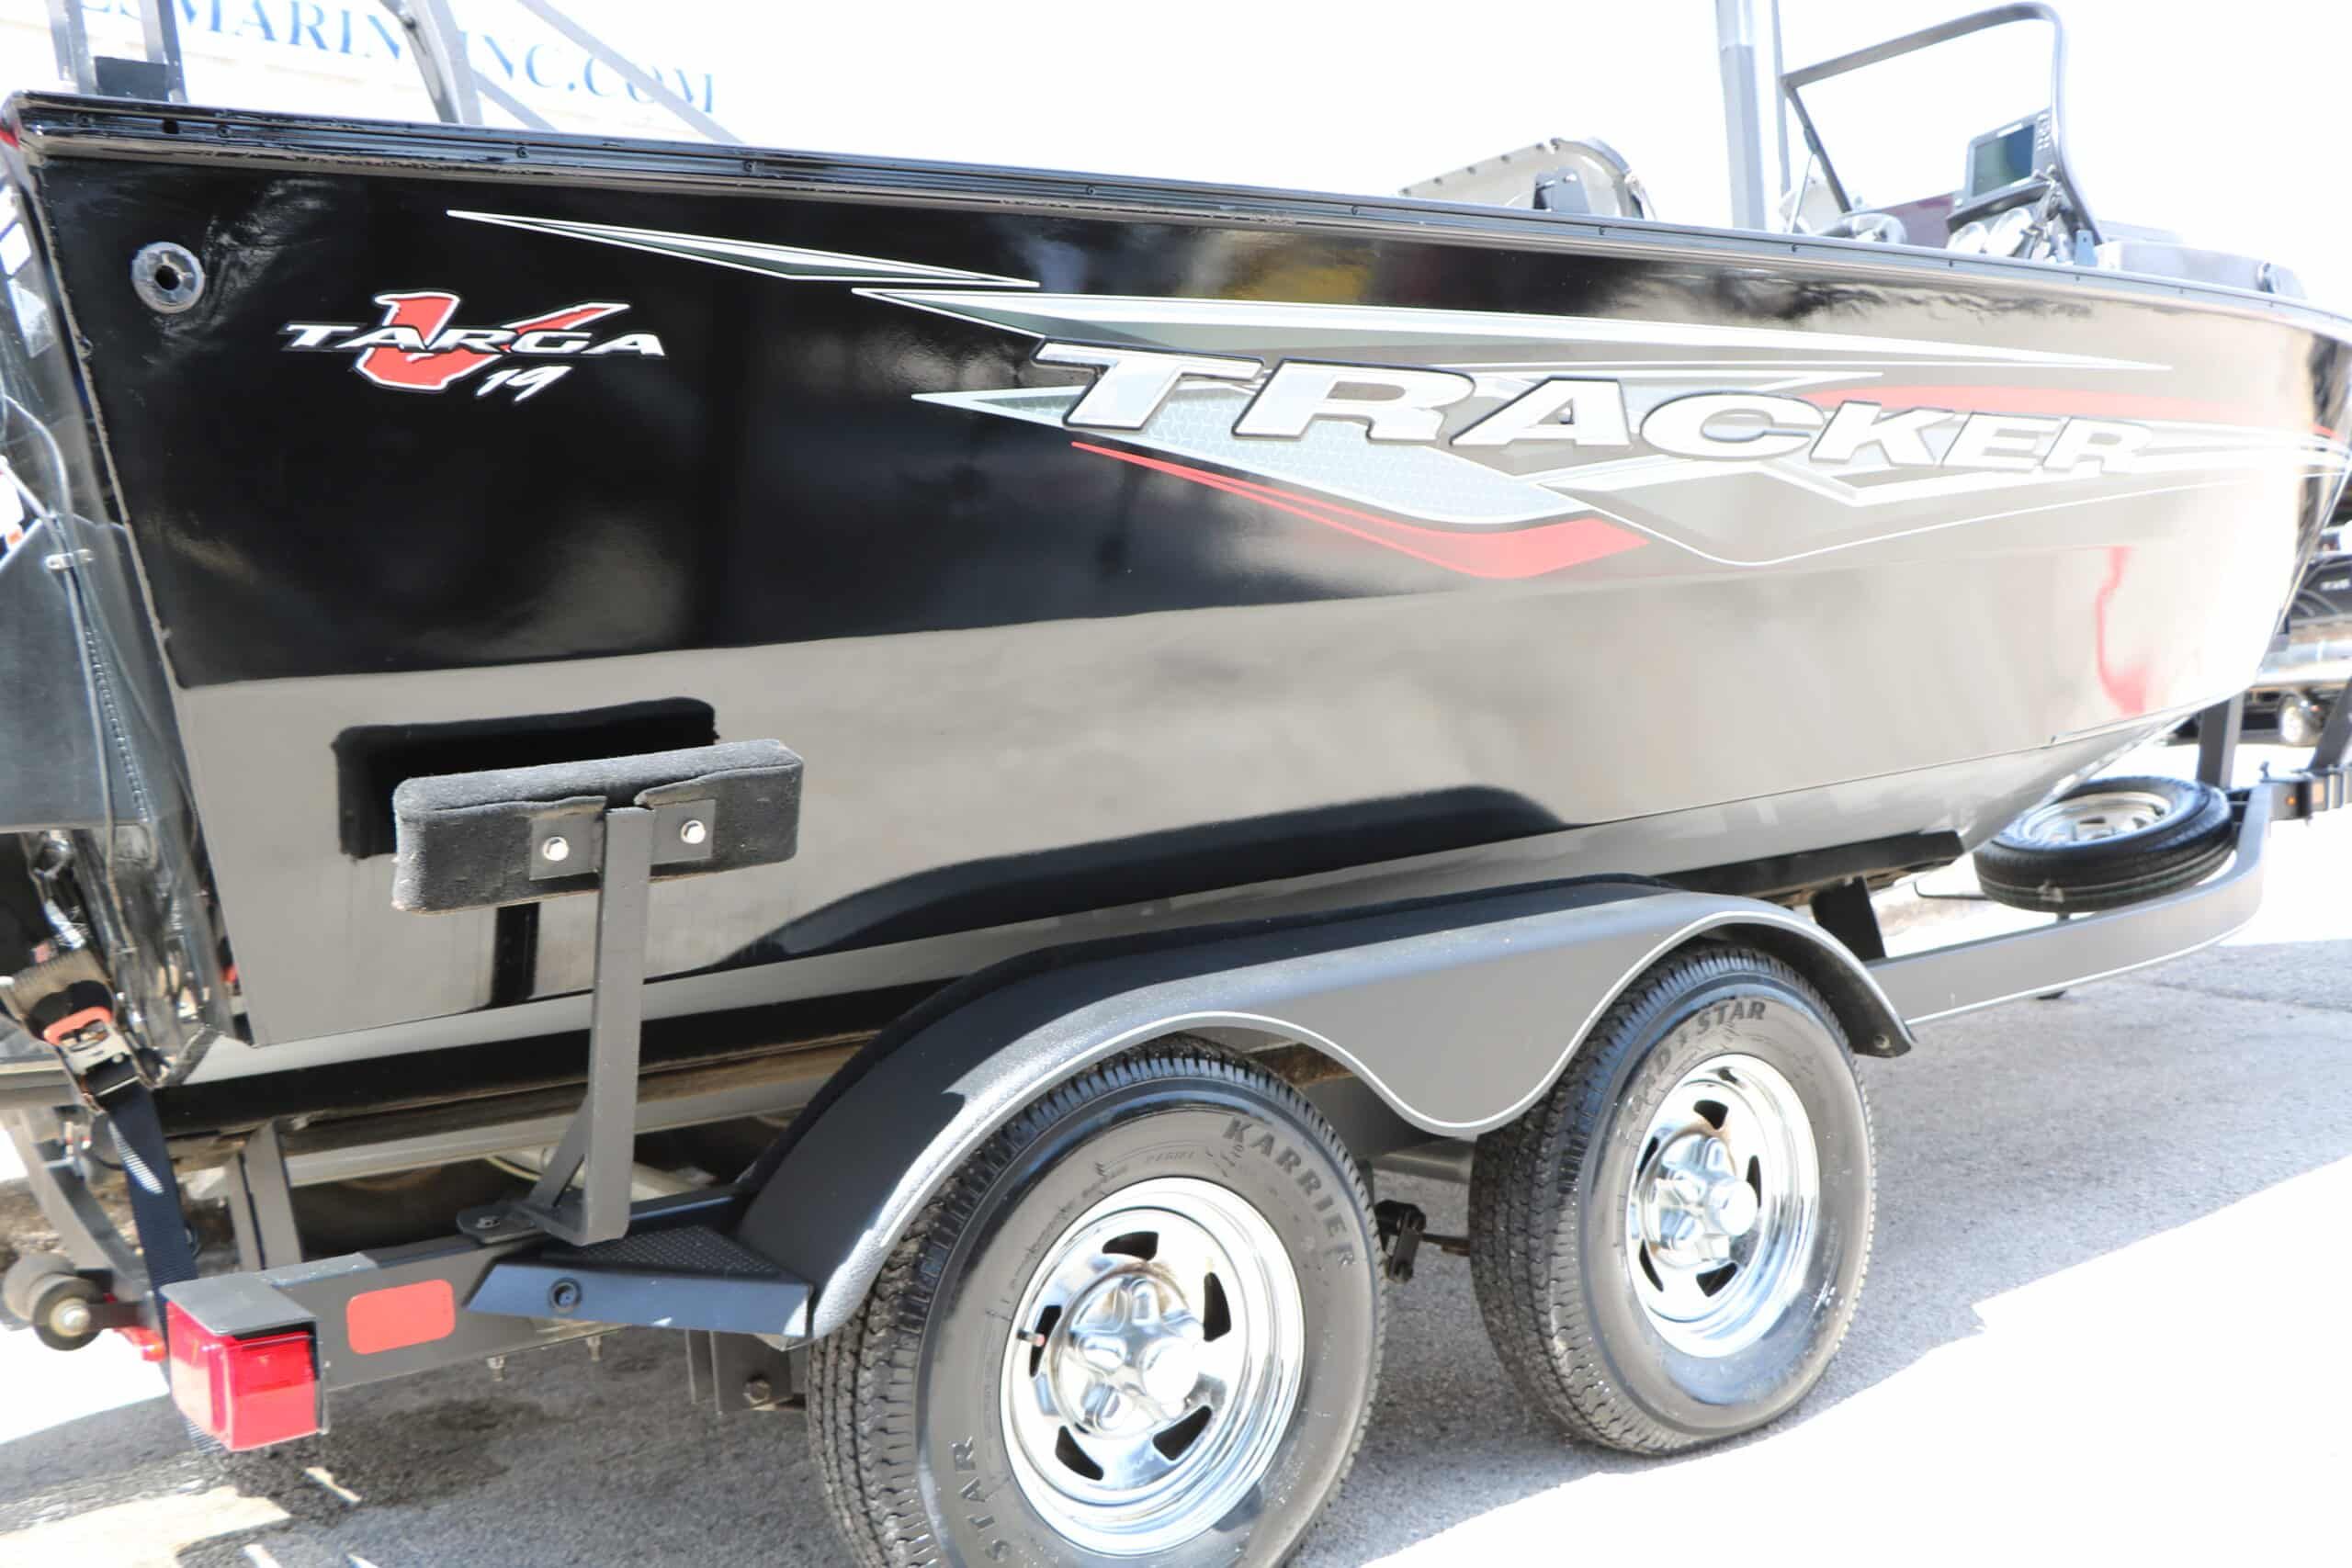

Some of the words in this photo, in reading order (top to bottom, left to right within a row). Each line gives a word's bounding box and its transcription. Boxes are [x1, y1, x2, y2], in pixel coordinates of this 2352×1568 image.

[278, 323, 665, 357] TARGA
[474, 365, 573, 403] 19
[1030, 336, 2153, 475] TRACKER
[1697, 1000, 1767, 1036] STAR
[1222, 1116, 1355, 1268] KARRIER
[949, 1435, 1010, 1562] STAR
